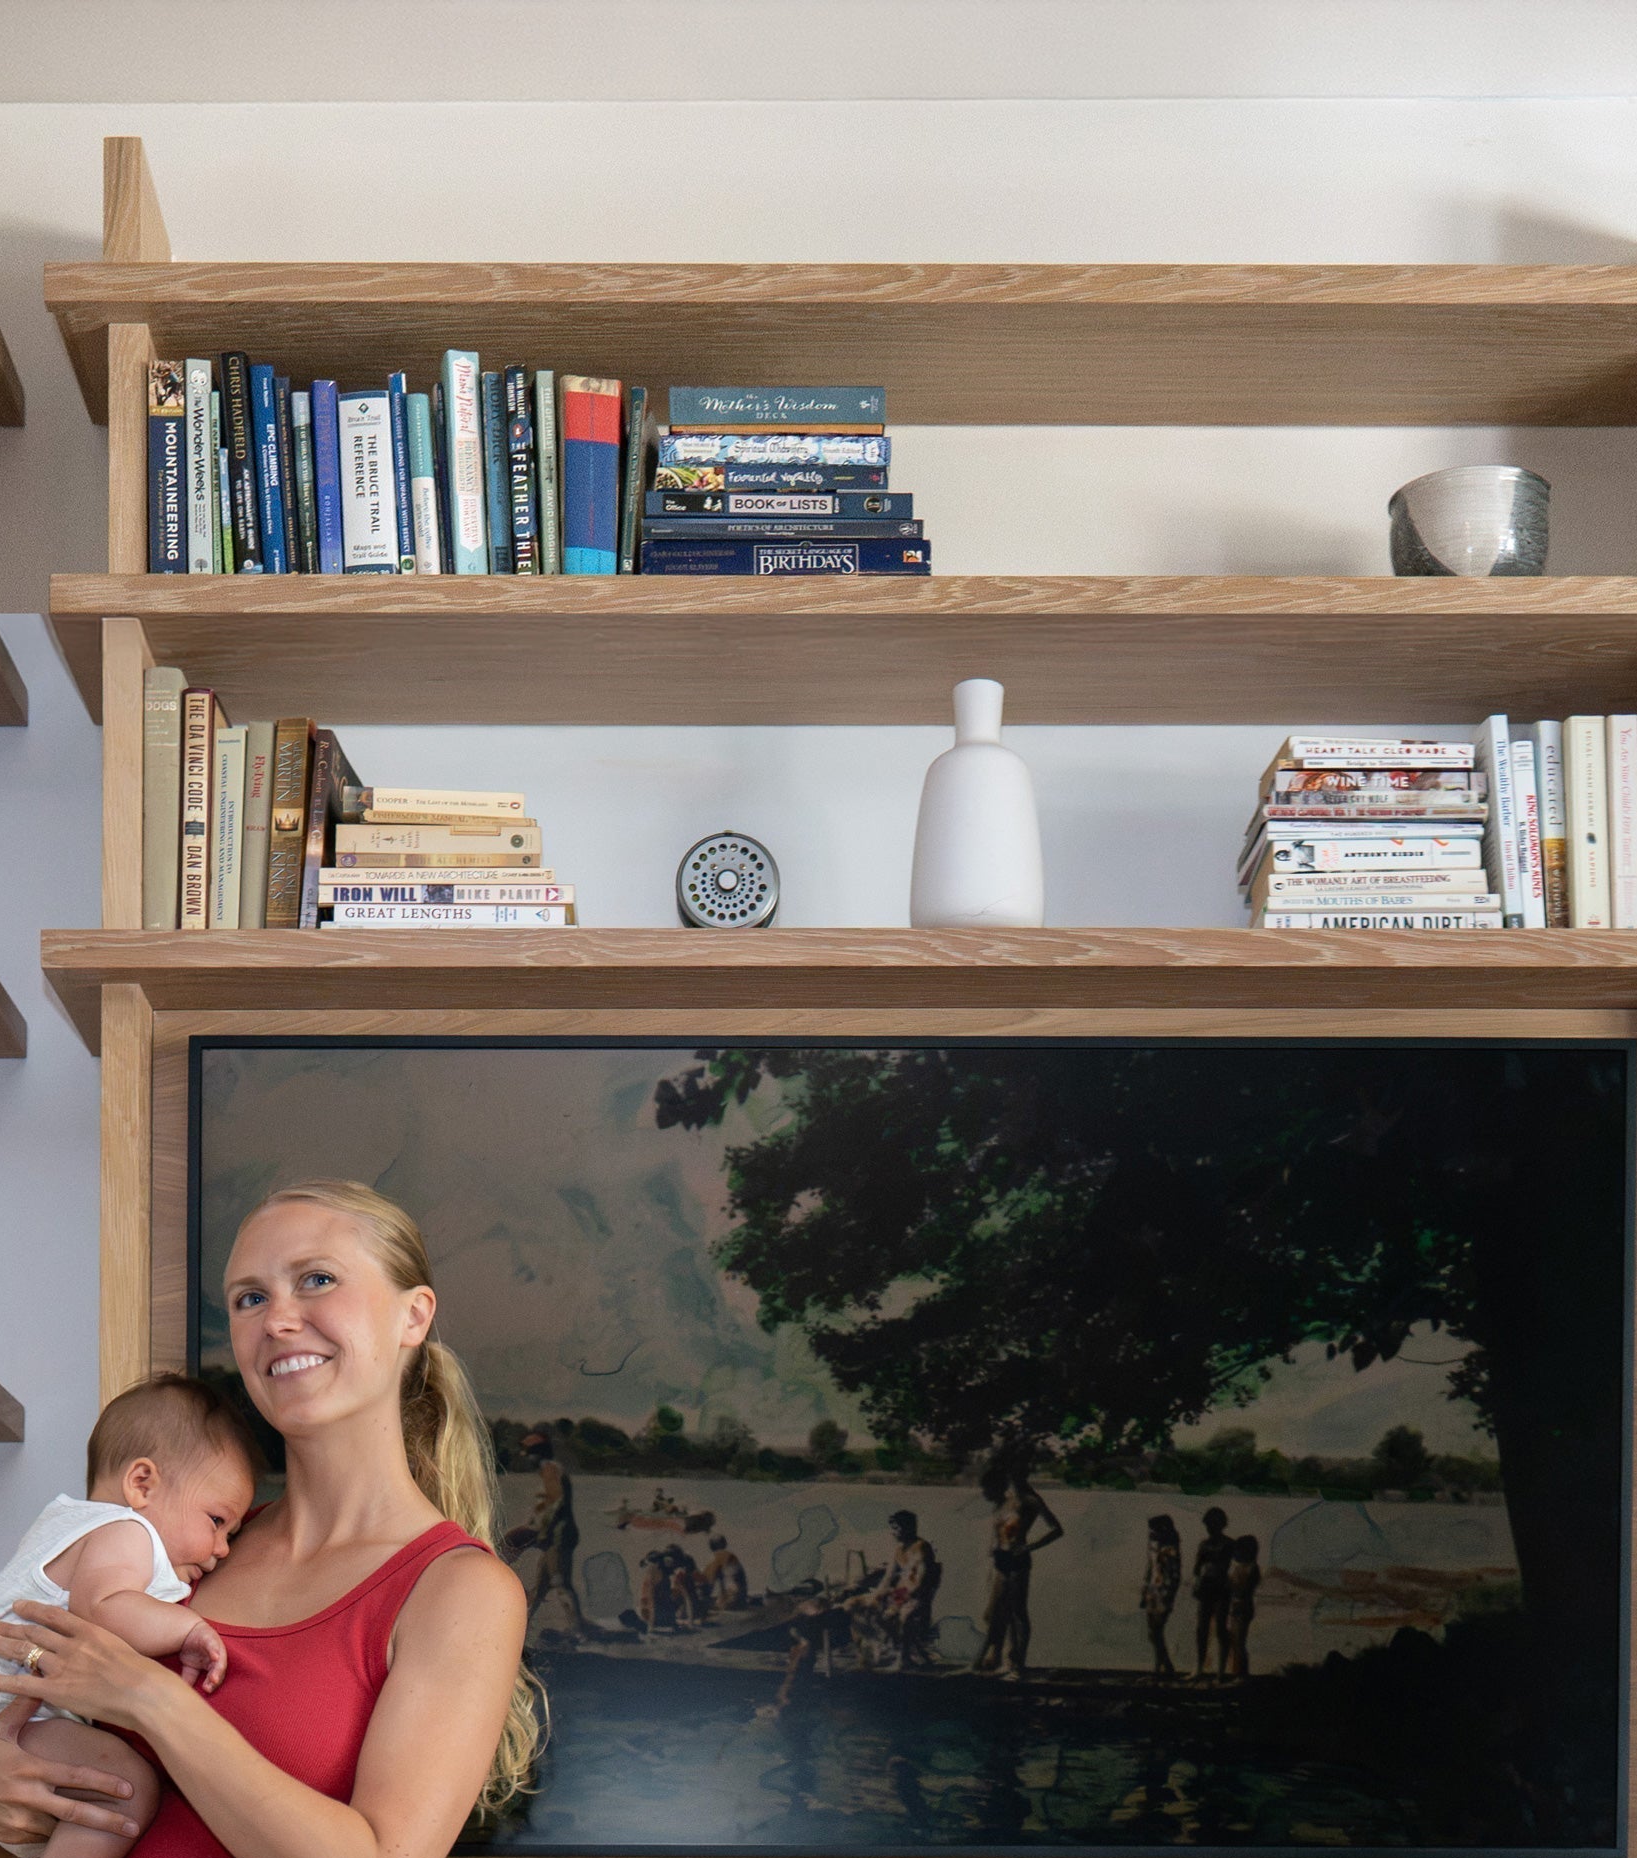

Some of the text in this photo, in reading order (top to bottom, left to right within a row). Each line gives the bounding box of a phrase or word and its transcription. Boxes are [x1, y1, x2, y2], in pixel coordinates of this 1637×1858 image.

[229, 357, 246, 459] CHRIS HADFIELD
[507, 383, 516, 411] JOHNSON
[193, 408, 204, 458] Wonder
[195, 459, 205, 501] Weeks
[268, 444, 278, 486] CLIMBING
[354, 436, 365, 499] REFERENCE
[368, 435, 380, 534] THE BRUCE TRAIL
[512, 454, 529, 525] FEATHER
[166, 423, 178, 560] MOUNTAINEERING
[735, 499, 774, 510] BOOK
[789, 499, 828, 510] LISTS
[402, 528, 410, 553] RESPECT
[759, 555, 855, 575] BIRTHDAYS
[188, 698, 205, 811] THE DA VINCI CODE
[1326, 777, 1409, 787] WINE TIME
[1496, 740, 1512, 827] The Wealthy Barber
[1545, 745, 1562, 826] educated
[1526, 795, 1542, 898] KING SOLOMON'S MINES
[186, 846, 201, 916] DAN BROWN
[217, 866, 225, 921] MANAGEMENT
[333, 888, 541, 901] IRON WILL MIKE PLANT
[1303, 877, 1347, 885] WOMANLY
[1383, 875, 1450, 883] BREASTFEEDING
[1317, 897, 1363, 905] MOUTHS
[345, 908, 472, 919] GREAT LENGTHS
